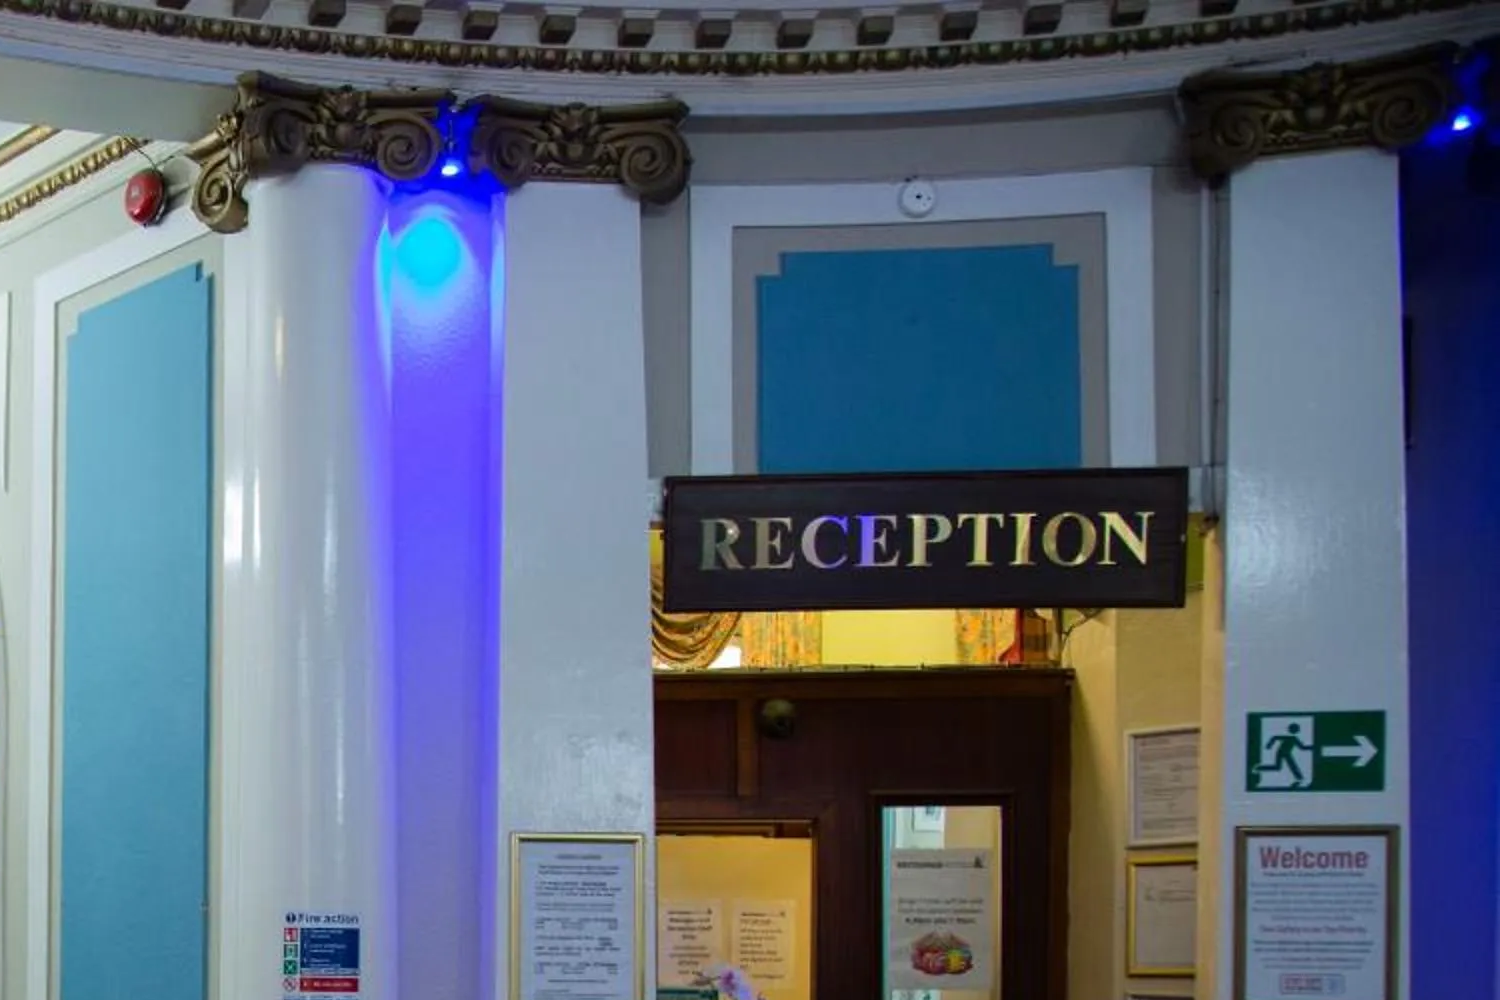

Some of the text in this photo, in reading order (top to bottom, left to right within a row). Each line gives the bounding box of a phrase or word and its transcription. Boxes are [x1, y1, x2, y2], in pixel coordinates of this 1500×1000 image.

[700, 510, 1155, 571] RECEPTION
[1259, 845, 1370, 869] Welcome
[298, 913, 358, 924] Fire action
